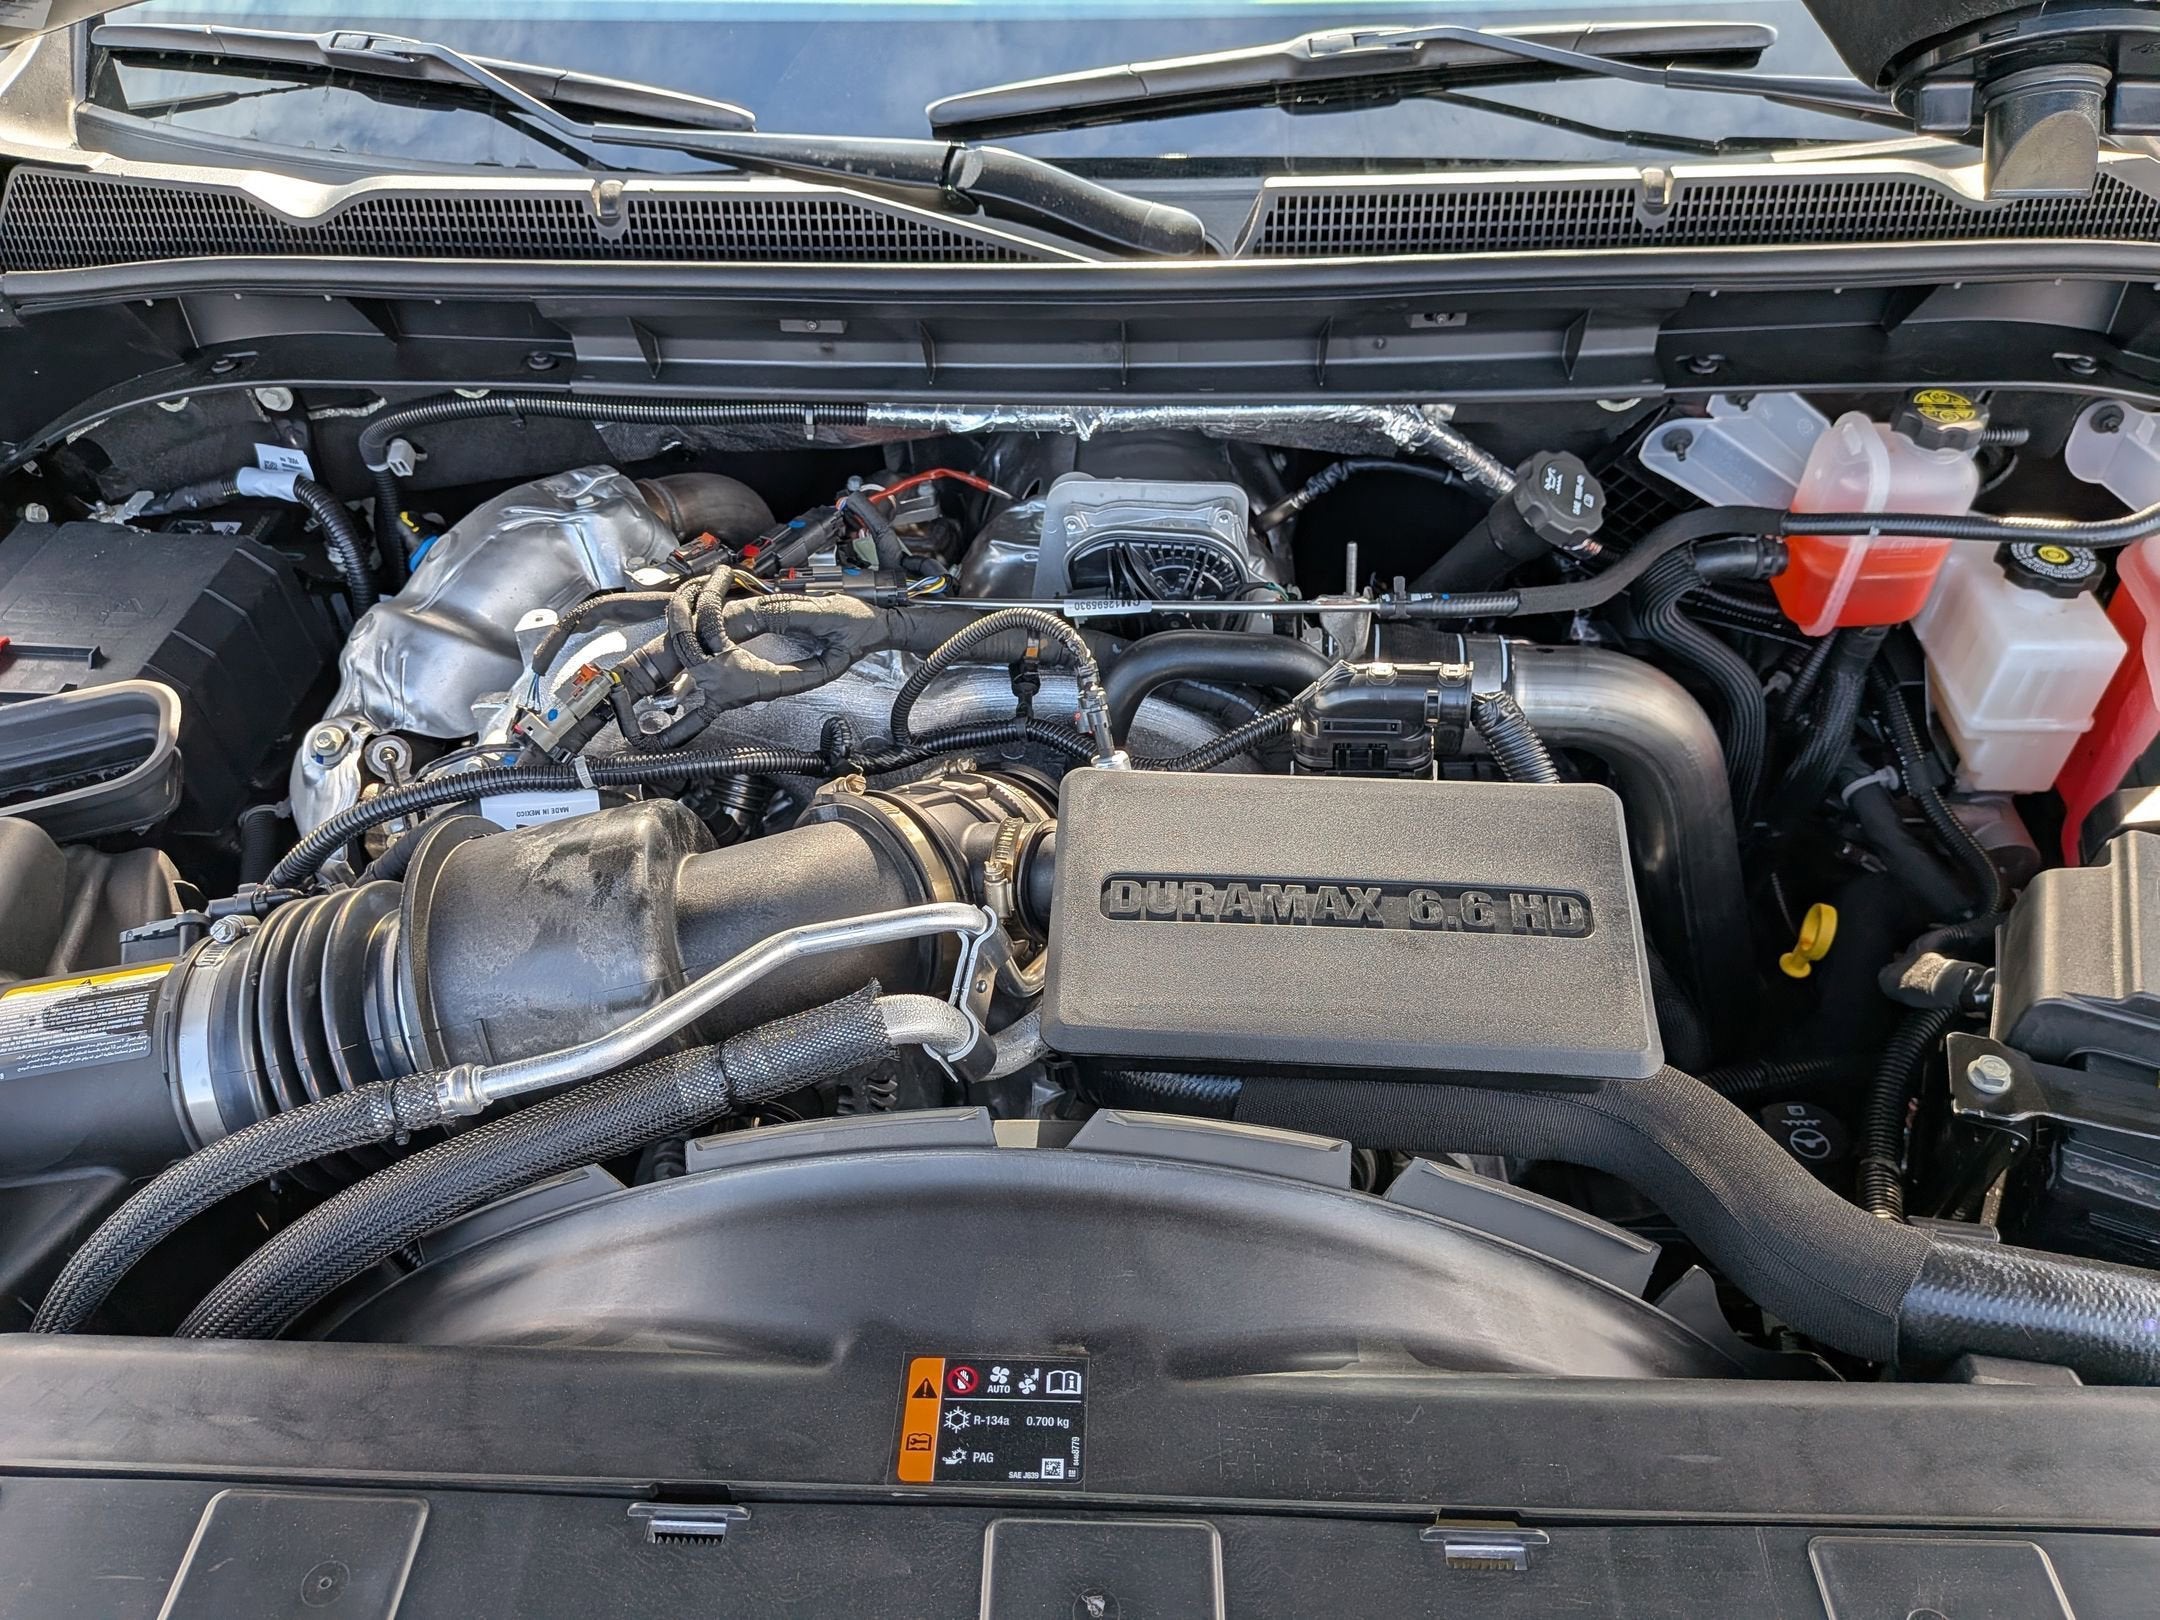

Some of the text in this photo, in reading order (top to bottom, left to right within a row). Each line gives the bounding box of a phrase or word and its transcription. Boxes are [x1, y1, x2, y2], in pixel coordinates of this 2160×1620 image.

[516, 809, 540, 817] MEXICO
[551, 806, 569, 814] MADE
[1109, 880, 1587, 934] DURAMAX 6.6 HD
[987, 1384, 1011, 1394] AUTO
[973, 1415, 1070, 1429] R-134a 0.700 kg
[972, 1451, 994, 1463] PAG
[1008, 1470, 1022, 1479] SAE
